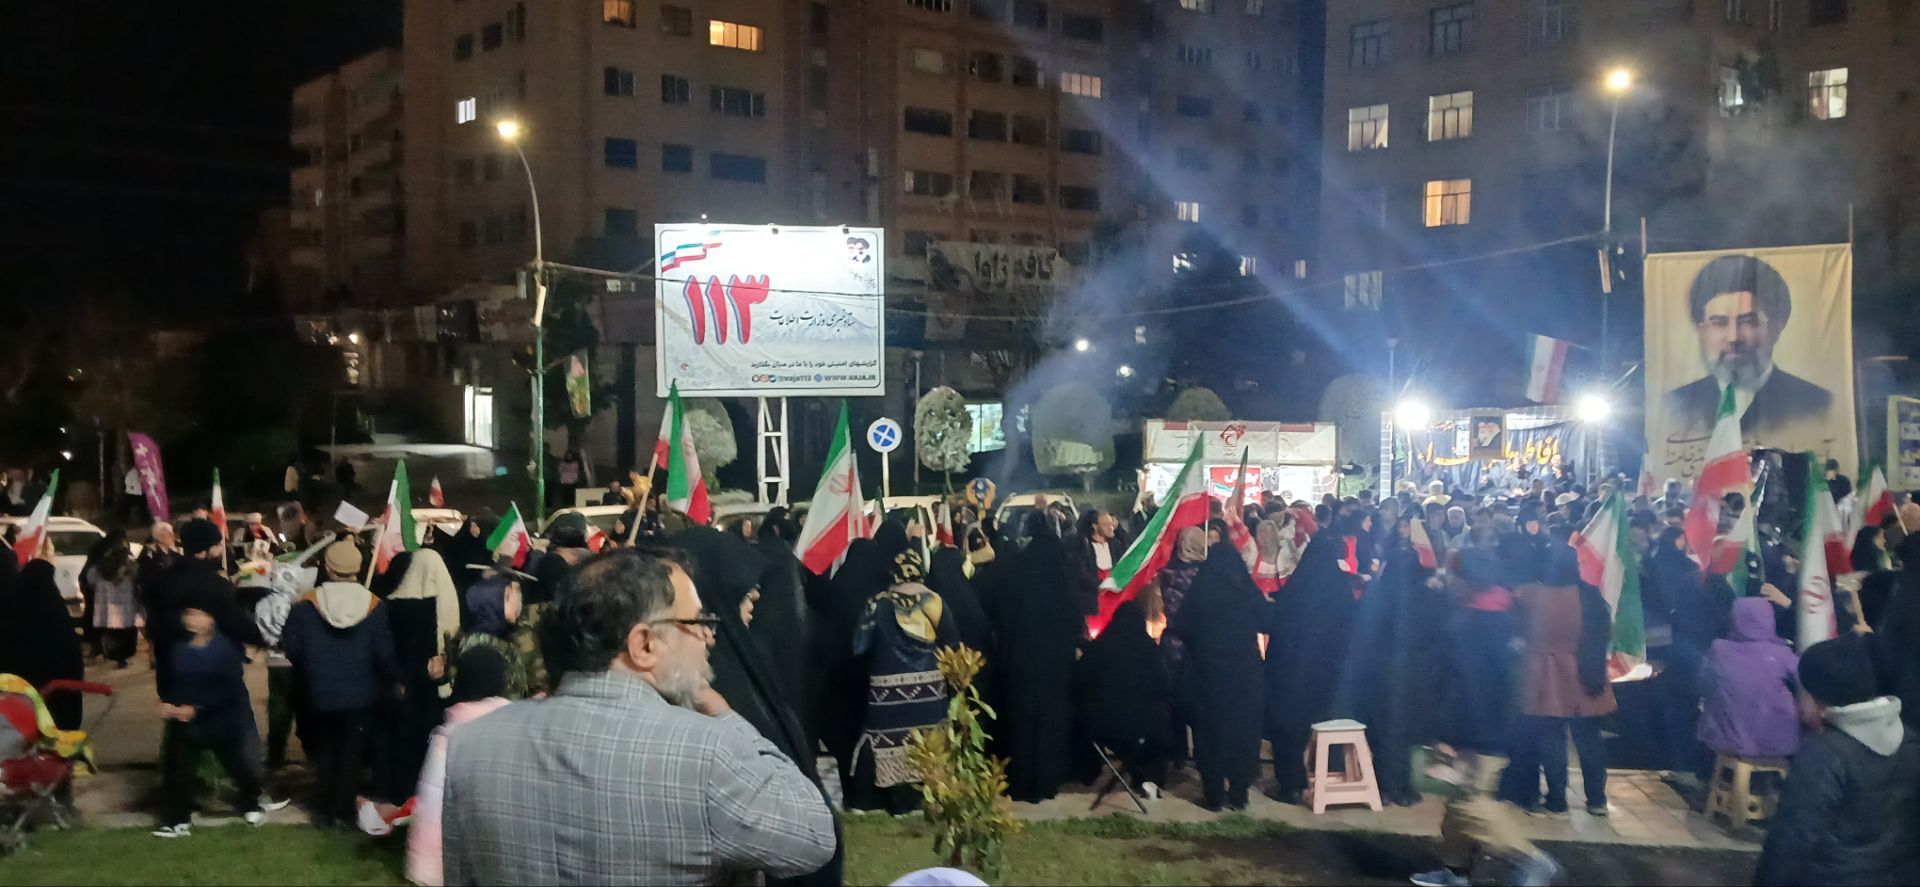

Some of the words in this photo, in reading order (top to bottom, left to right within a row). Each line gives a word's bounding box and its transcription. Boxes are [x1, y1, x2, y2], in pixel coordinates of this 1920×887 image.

[683, 274, 769, 344] ۱۱۳
[770, 310, 799, 326] اطلاعات
[800, 310, 825, 327] وزارت
